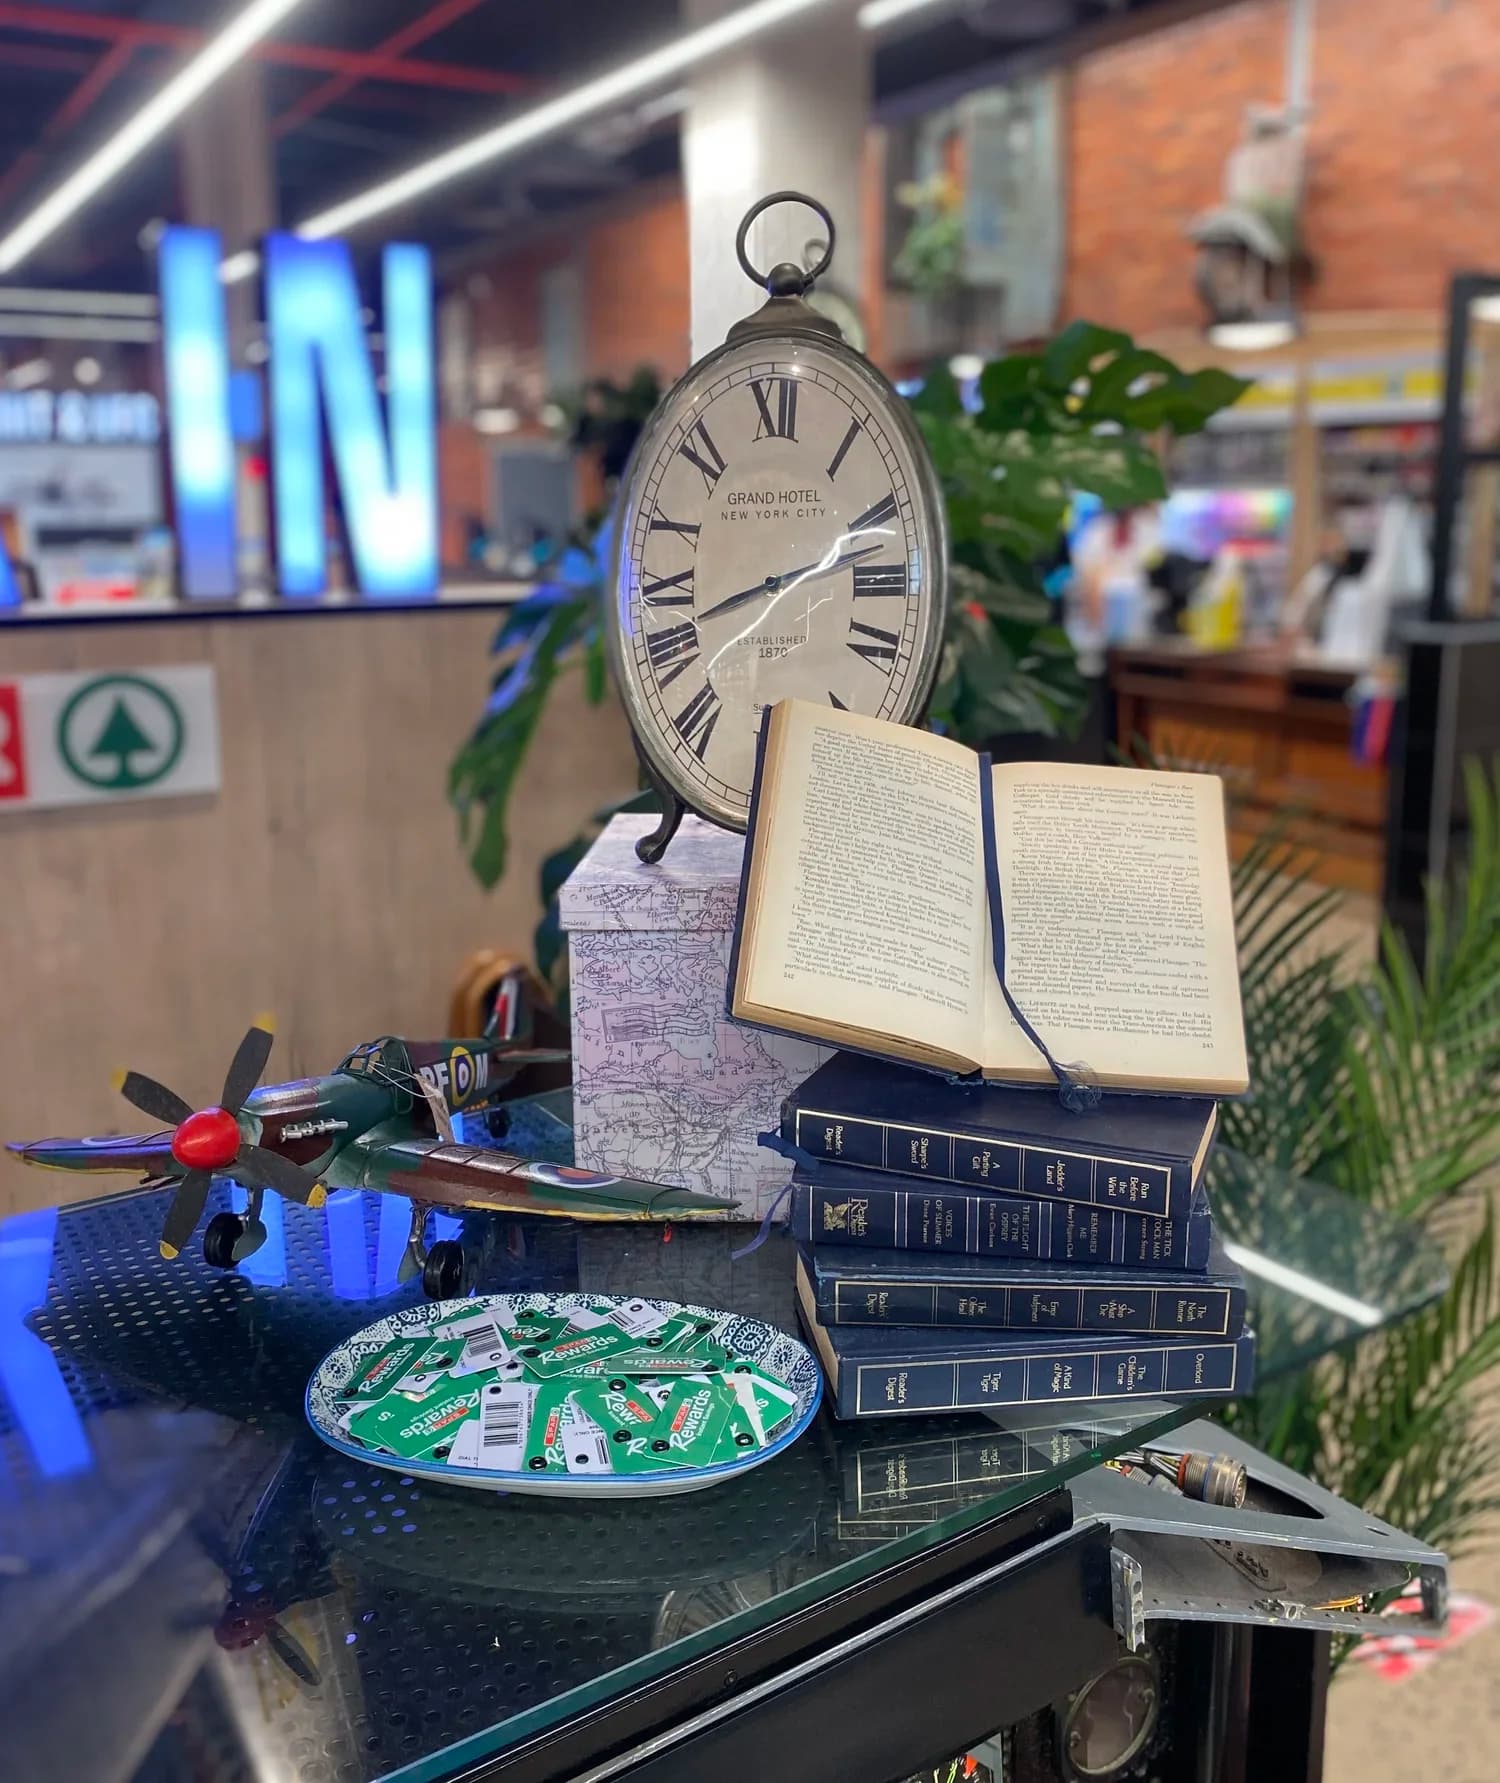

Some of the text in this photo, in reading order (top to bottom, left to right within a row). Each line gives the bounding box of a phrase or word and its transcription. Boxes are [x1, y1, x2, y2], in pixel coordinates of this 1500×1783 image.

[159, 226, 439, 600] IN
[747, 377, 802, 442] XII
[727, 489, 821, 506] GRAND HOTEL
[721, 508, 826, 520] NEW YORK CITY
[737, 635, 807, 646] ESTABLISHED
[758, 647, 788, 658] 1870
[824, 1127, 833, 1151] Digest
[835, 1125, 844, 1156] Reader's
[911, 1140, 919, 1164] Sword
[919, 1137, 929, 1169] Sharpe's
[972, 1156, 981, 1170] Gift
[981, 1151, 991, 1177] Parting
[993, 1161, 1001, 1169] A
[1046, 1165, 1055, 1185] Land
[1108, 1176, 1117, 1197] Wind
[1119, 1181, 1128, 1194] the
[1130, 1176, 1139, 1202] Before
[1140, 1182, 1150, 1199] Run
[935, 1199, 943, 1212] OF
[850, 1198, 869, 1237] Reader's
[945, 1209, 953, 1238] VOICES
[1001, 1212, 1009, 1242] OSPREY
[1165, 1221, 1173, 1237] THE
[1177, 1300, 1187, 1323] Runner
[1186, 1302, 1197, 1322] North
[1197, 1305, 1207, 1319] The
[537, 1335, 619, 1365] Rewards
[358, 1343, 415, 1393] Rewards
[623, 1358, 713, 1368] Rewards
[1117, 1362, 1126, 1385] Game
[1126, 1355, 1136, 1391] Children's
[1137, 1365, 1147, 1380] The
[885, 1377, 897, 1401] Digest
[898, 1372, 908, 1404] Reader's
[980, 1372, 991, 1392] Tiger
[1051, 1371, 1062, 1393] Magic
[1063, 1373, 1072, 1390] Kind
[399, 1388, 480, 1439] Rewards
[669, 1389, 712, 1452] Rewards
